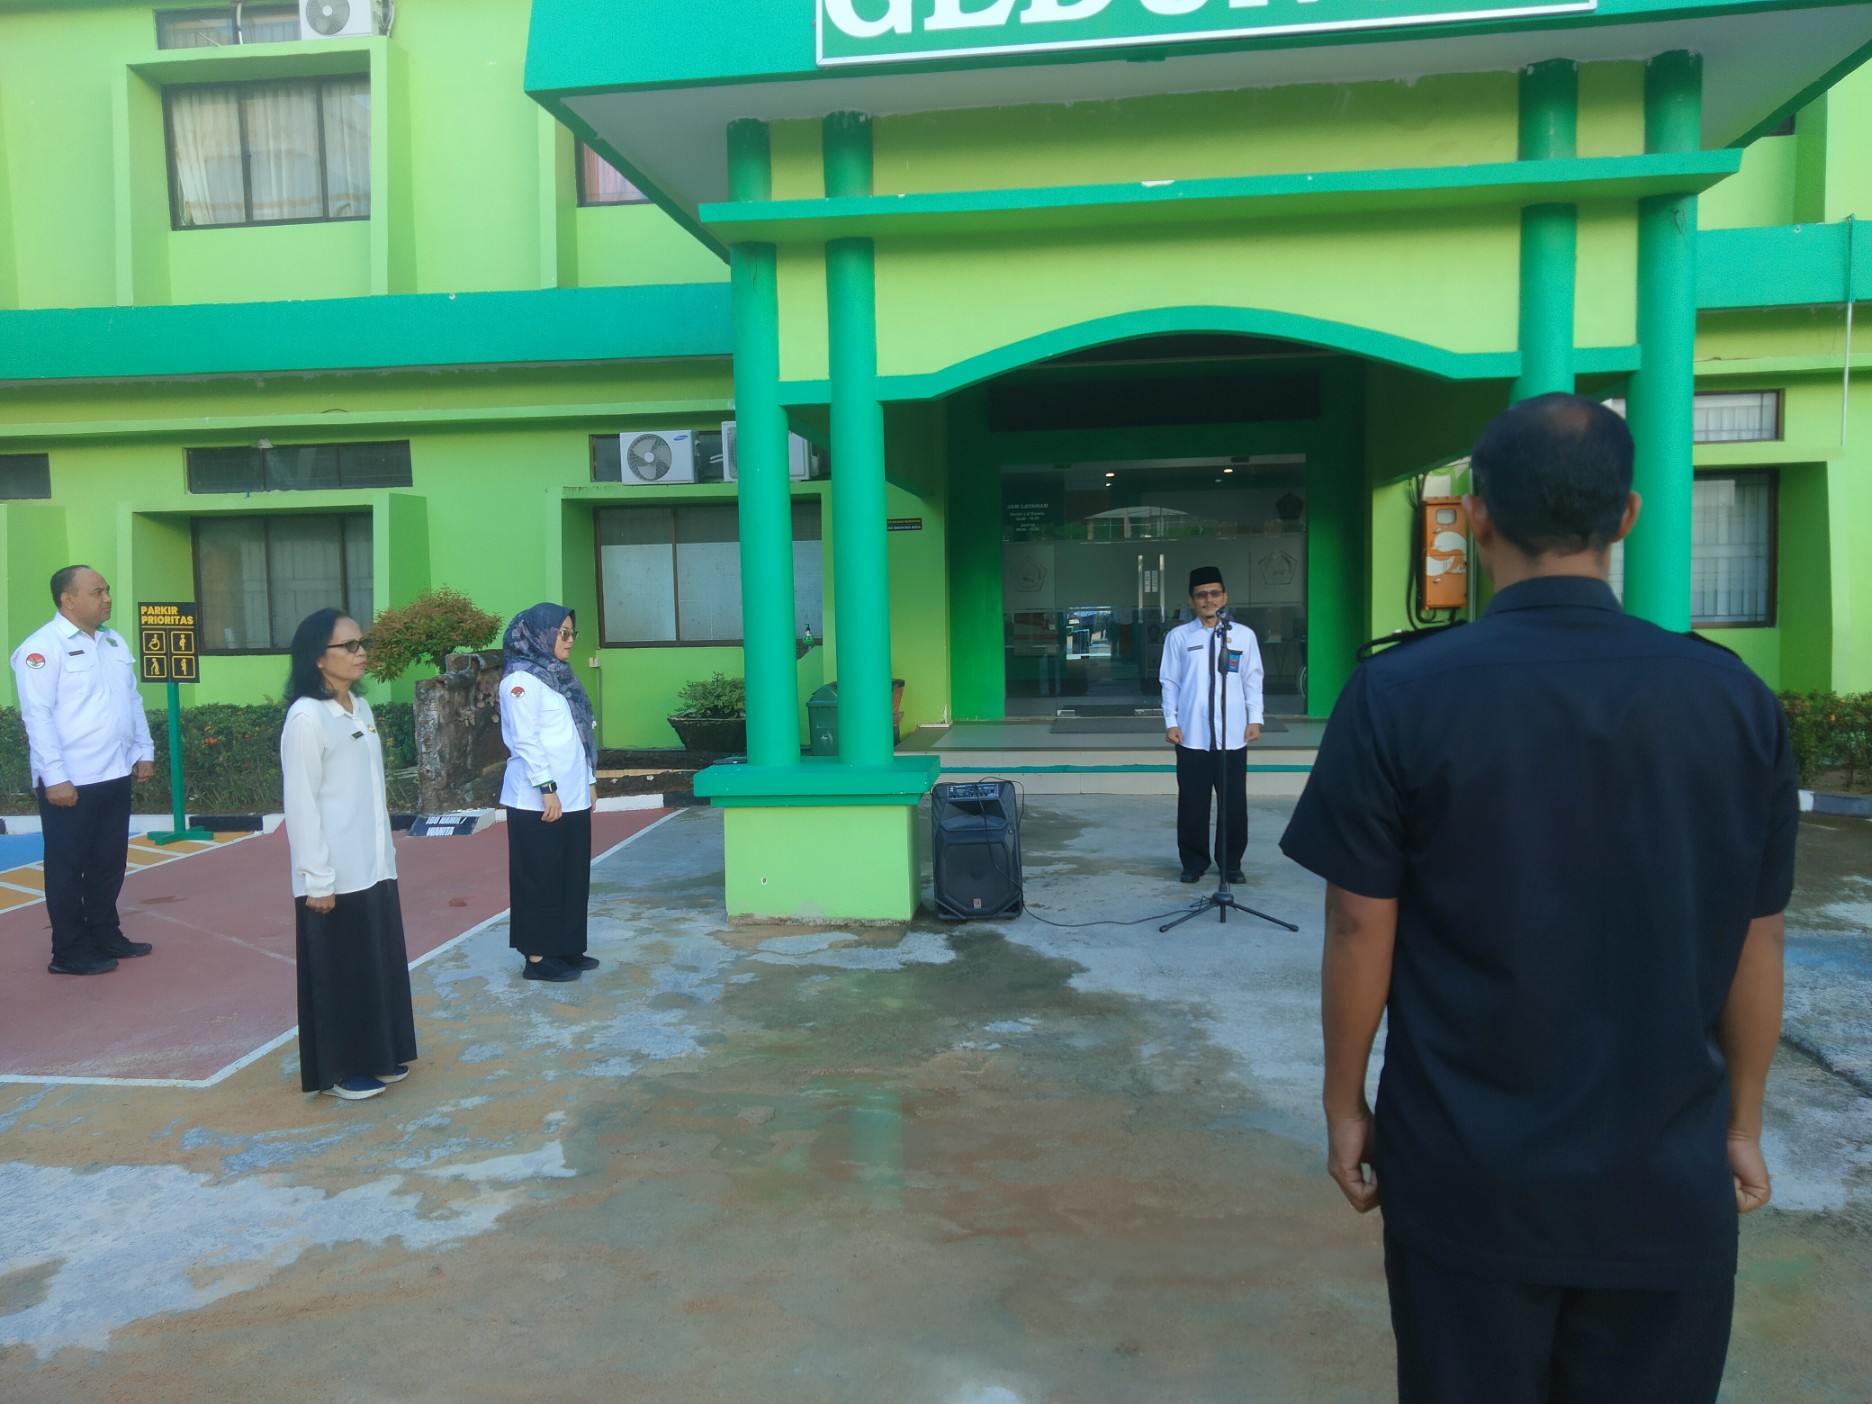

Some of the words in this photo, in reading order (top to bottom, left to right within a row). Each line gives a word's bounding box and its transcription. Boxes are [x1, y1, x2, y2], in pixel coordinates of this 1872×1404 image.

[140, 606, 178, 615] PARKIR
[141, 615, 194, 625] PRIORITAS
[426, 826, 455, 837] WANITA
